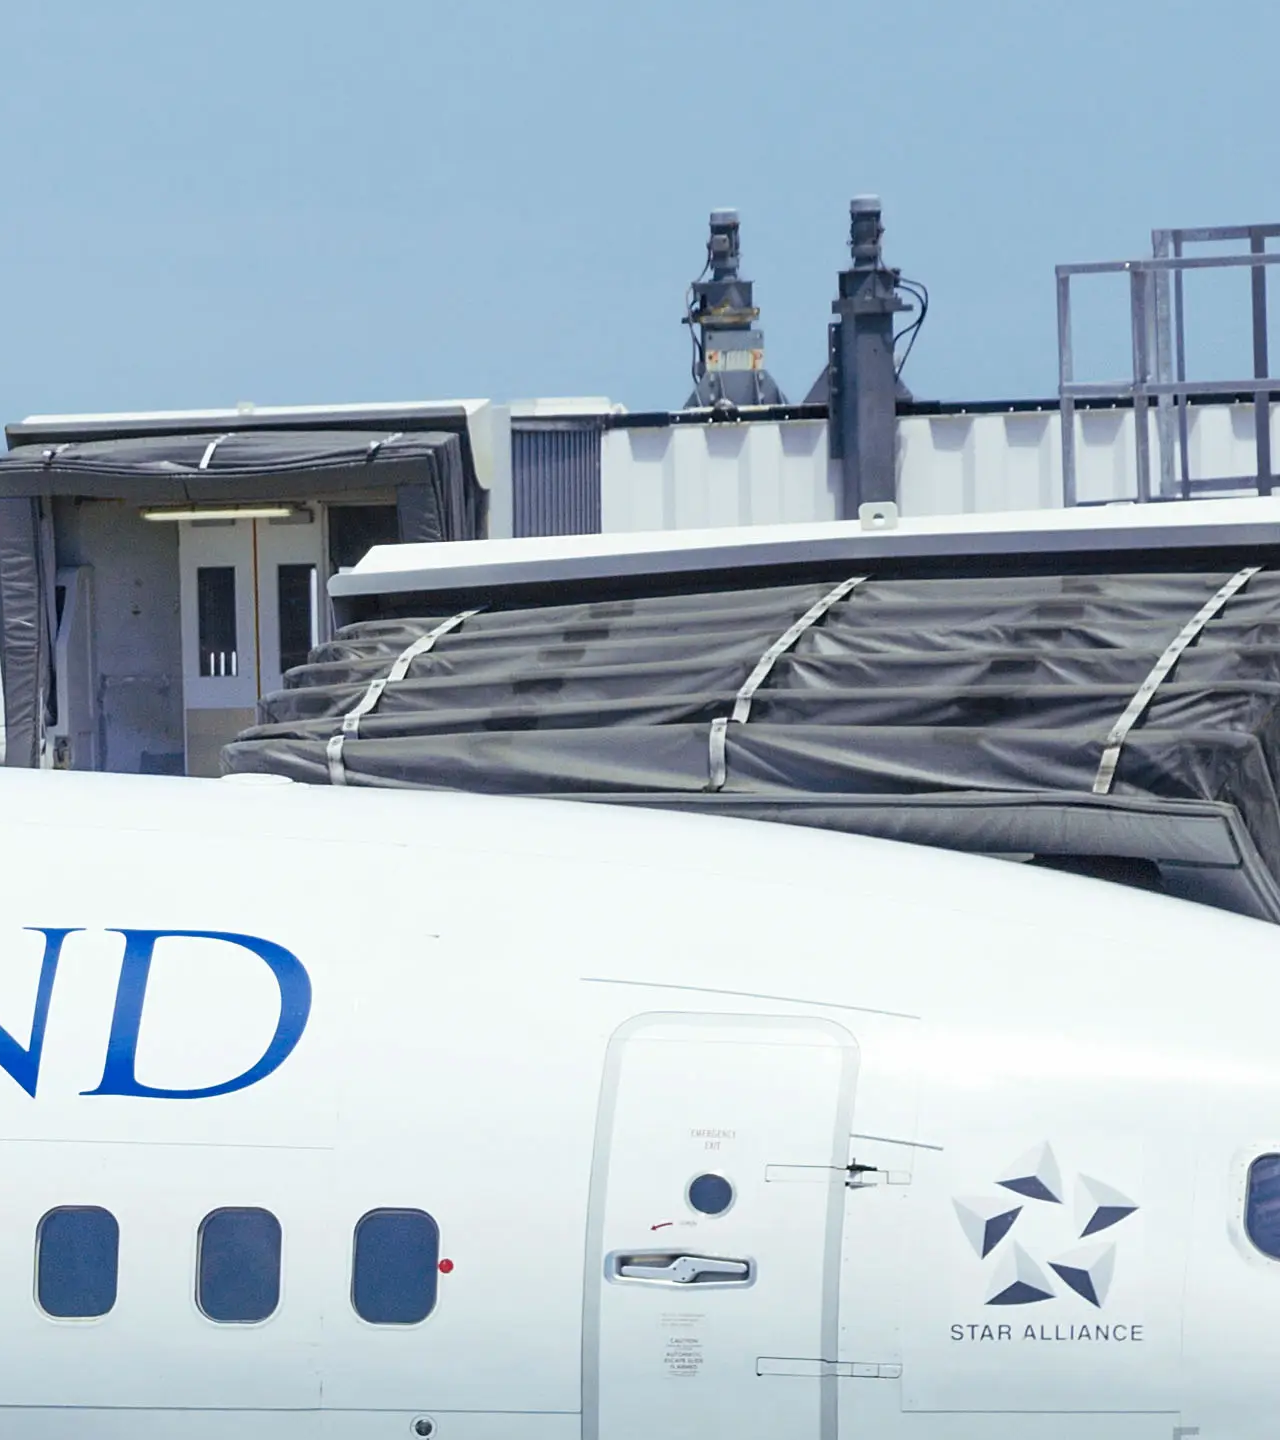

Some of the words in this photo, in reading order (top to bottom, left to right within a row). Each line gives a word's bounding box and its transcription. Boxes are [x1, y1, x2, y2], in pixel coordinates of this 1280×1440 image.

[689, 1127, 737, 1139] EMERGENCY
[704, 1141, 721, 1150] EXIT
[950, 1324, 1002, 1341] STAR
[1023, 1324, 1144, 1341] ALLIANCE
